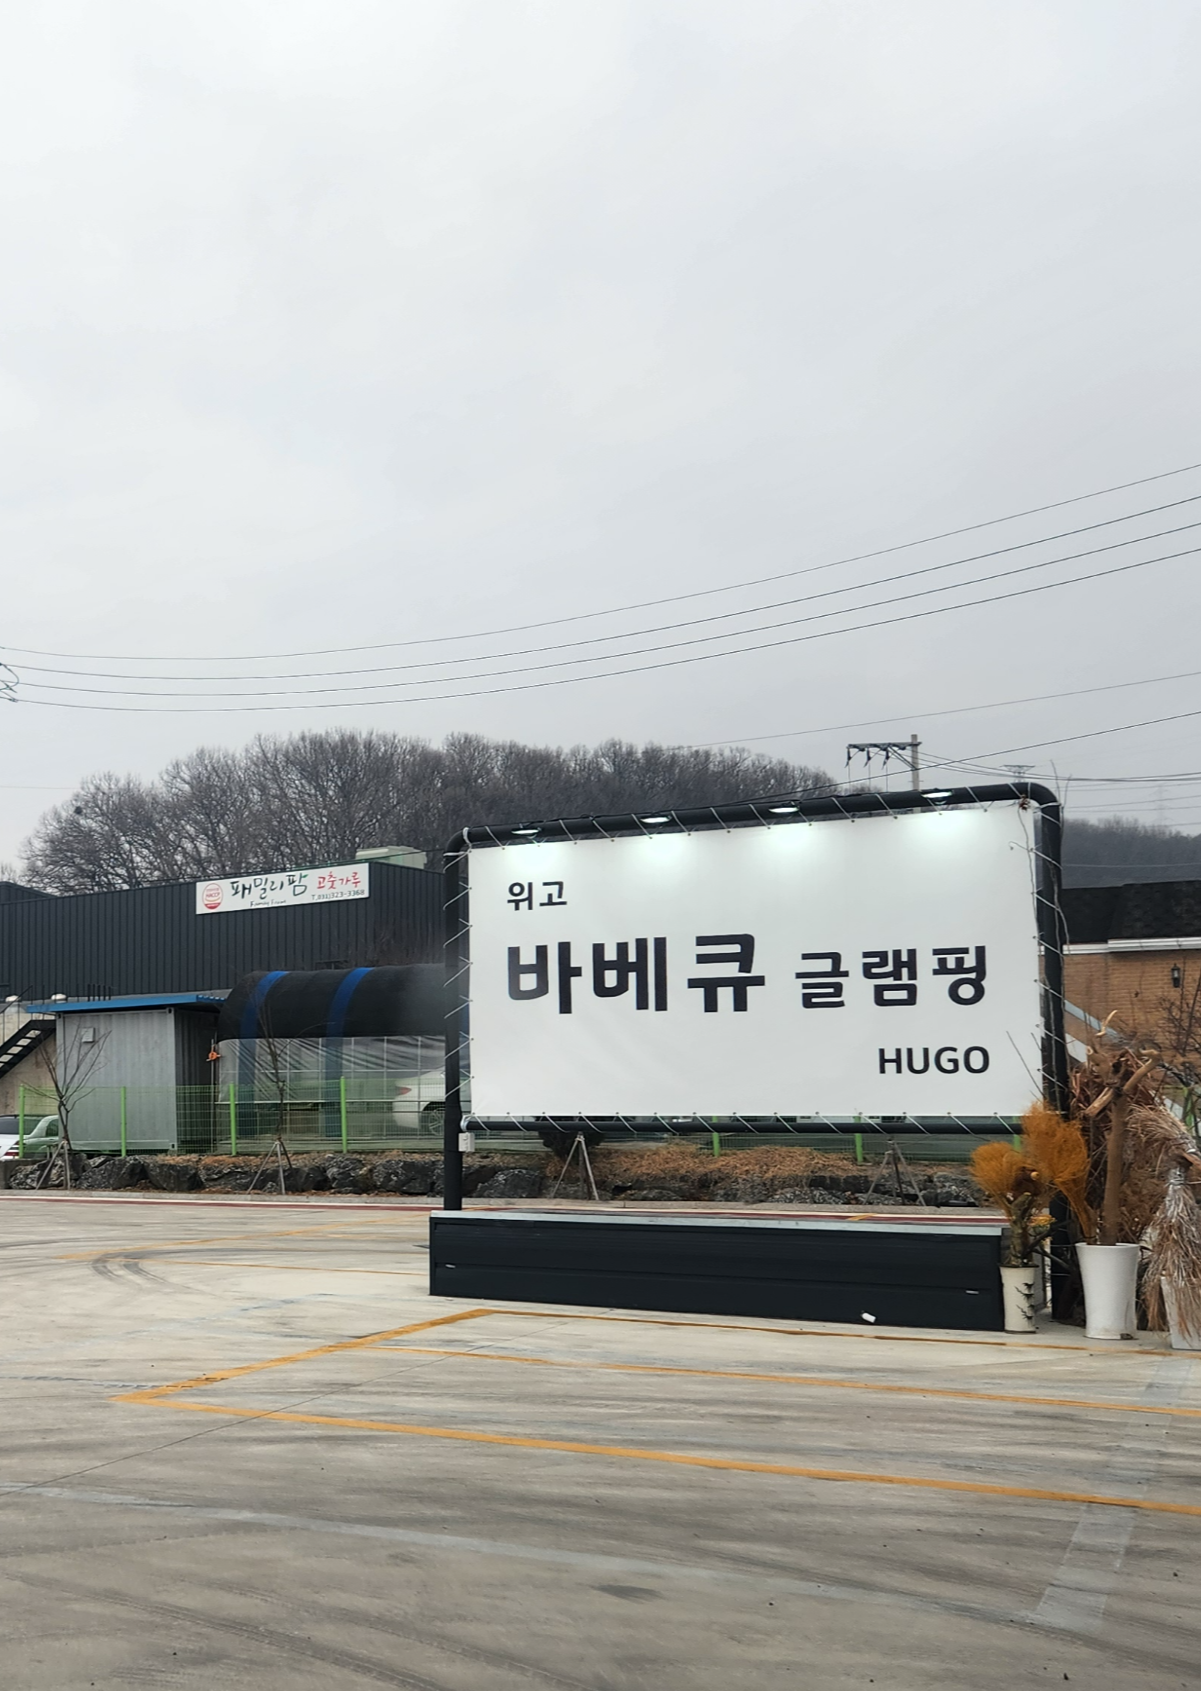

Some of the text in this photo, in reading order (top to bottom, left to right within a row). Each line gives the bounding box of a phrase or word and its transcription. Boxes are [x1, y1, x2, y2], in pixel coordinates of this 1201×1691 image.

[230, 871, 361, 900] 패밀리팜 고춧가루
[507, 881, 567, 911] 위고
[507, 933, 987, 1014] 바베큐 글램핑
[878, 1046, 990, 1075] HUGO
